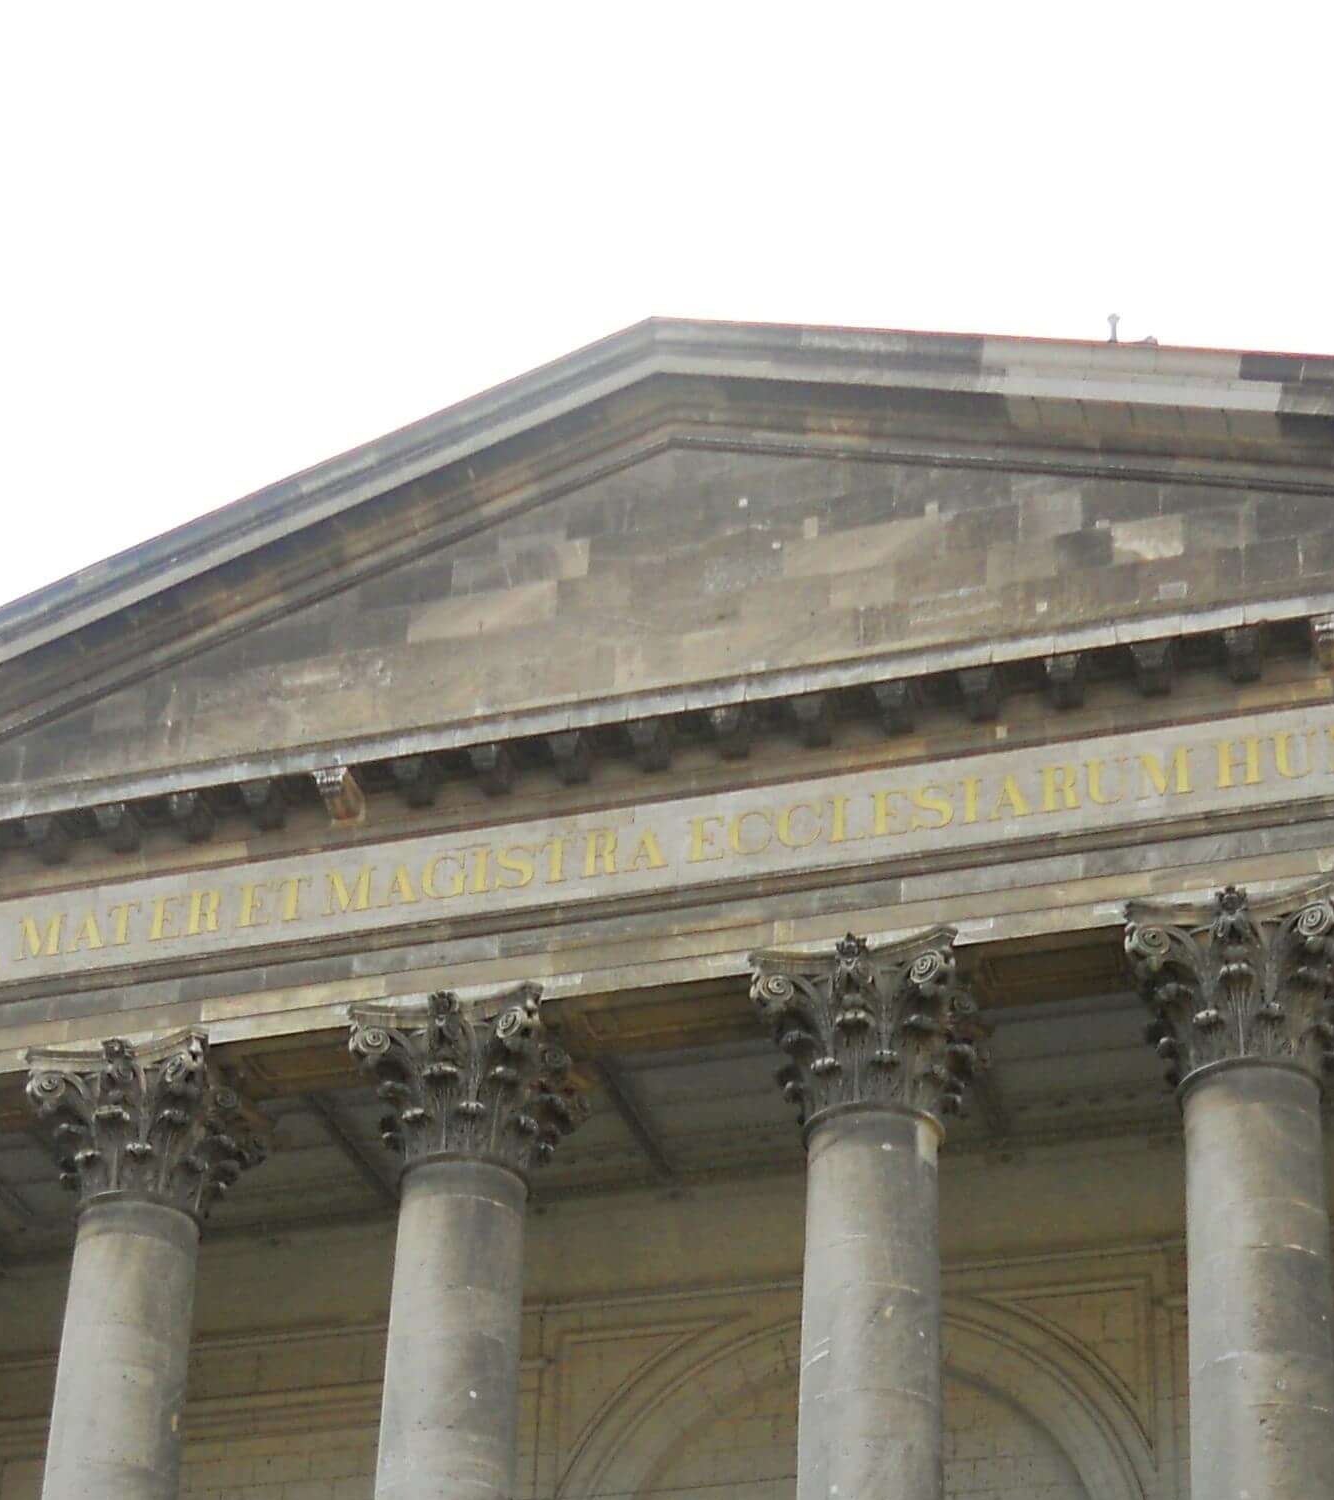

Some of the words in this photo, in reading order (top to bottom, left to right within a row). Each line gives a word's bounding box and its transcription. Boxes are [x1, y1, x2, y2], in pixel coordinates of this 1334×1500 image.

[11, 888, 220, 962] MATER
[235, 875, 313, 930] ET
[320, 825, 668, 915] MAGISTRA
[685, 746, 1194, 864] ECCLESIARUM
